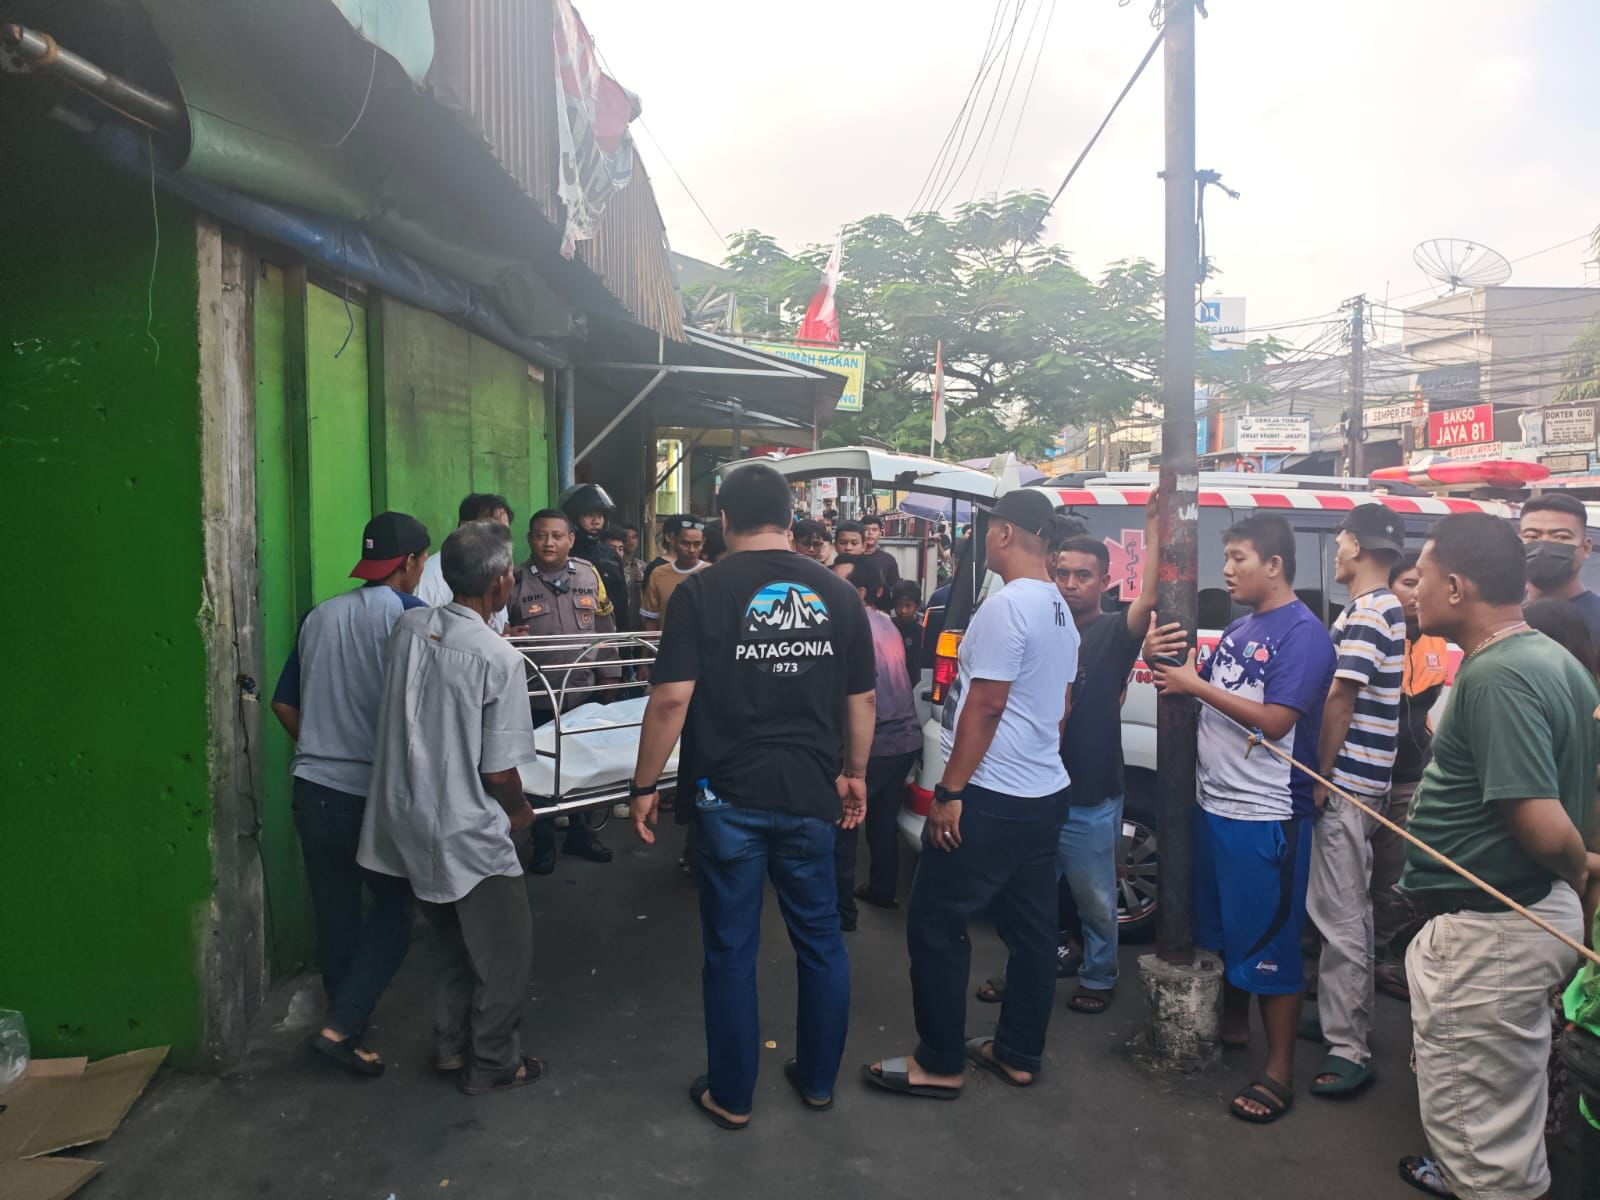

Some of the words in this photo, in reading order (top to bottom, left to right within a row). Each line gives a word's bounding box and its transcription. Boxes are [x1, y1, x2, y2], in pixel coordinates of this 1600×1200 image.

[819, 355, 859, 369] MAKAN
[1373, 408, 1400, 421] SEMPER
[1443, 408, 1475, 425] BAKSO
[1545, 411, 1574, 420] DOKTER
[1577, 409, 1593, 418] GIGI
[1436, 425, 1468, 445] JAYA
[1471, 422, 1486, 441] 81
[735, 641, 834, 660] PATAGONIA
[773, 663, 798, 673] 1973
